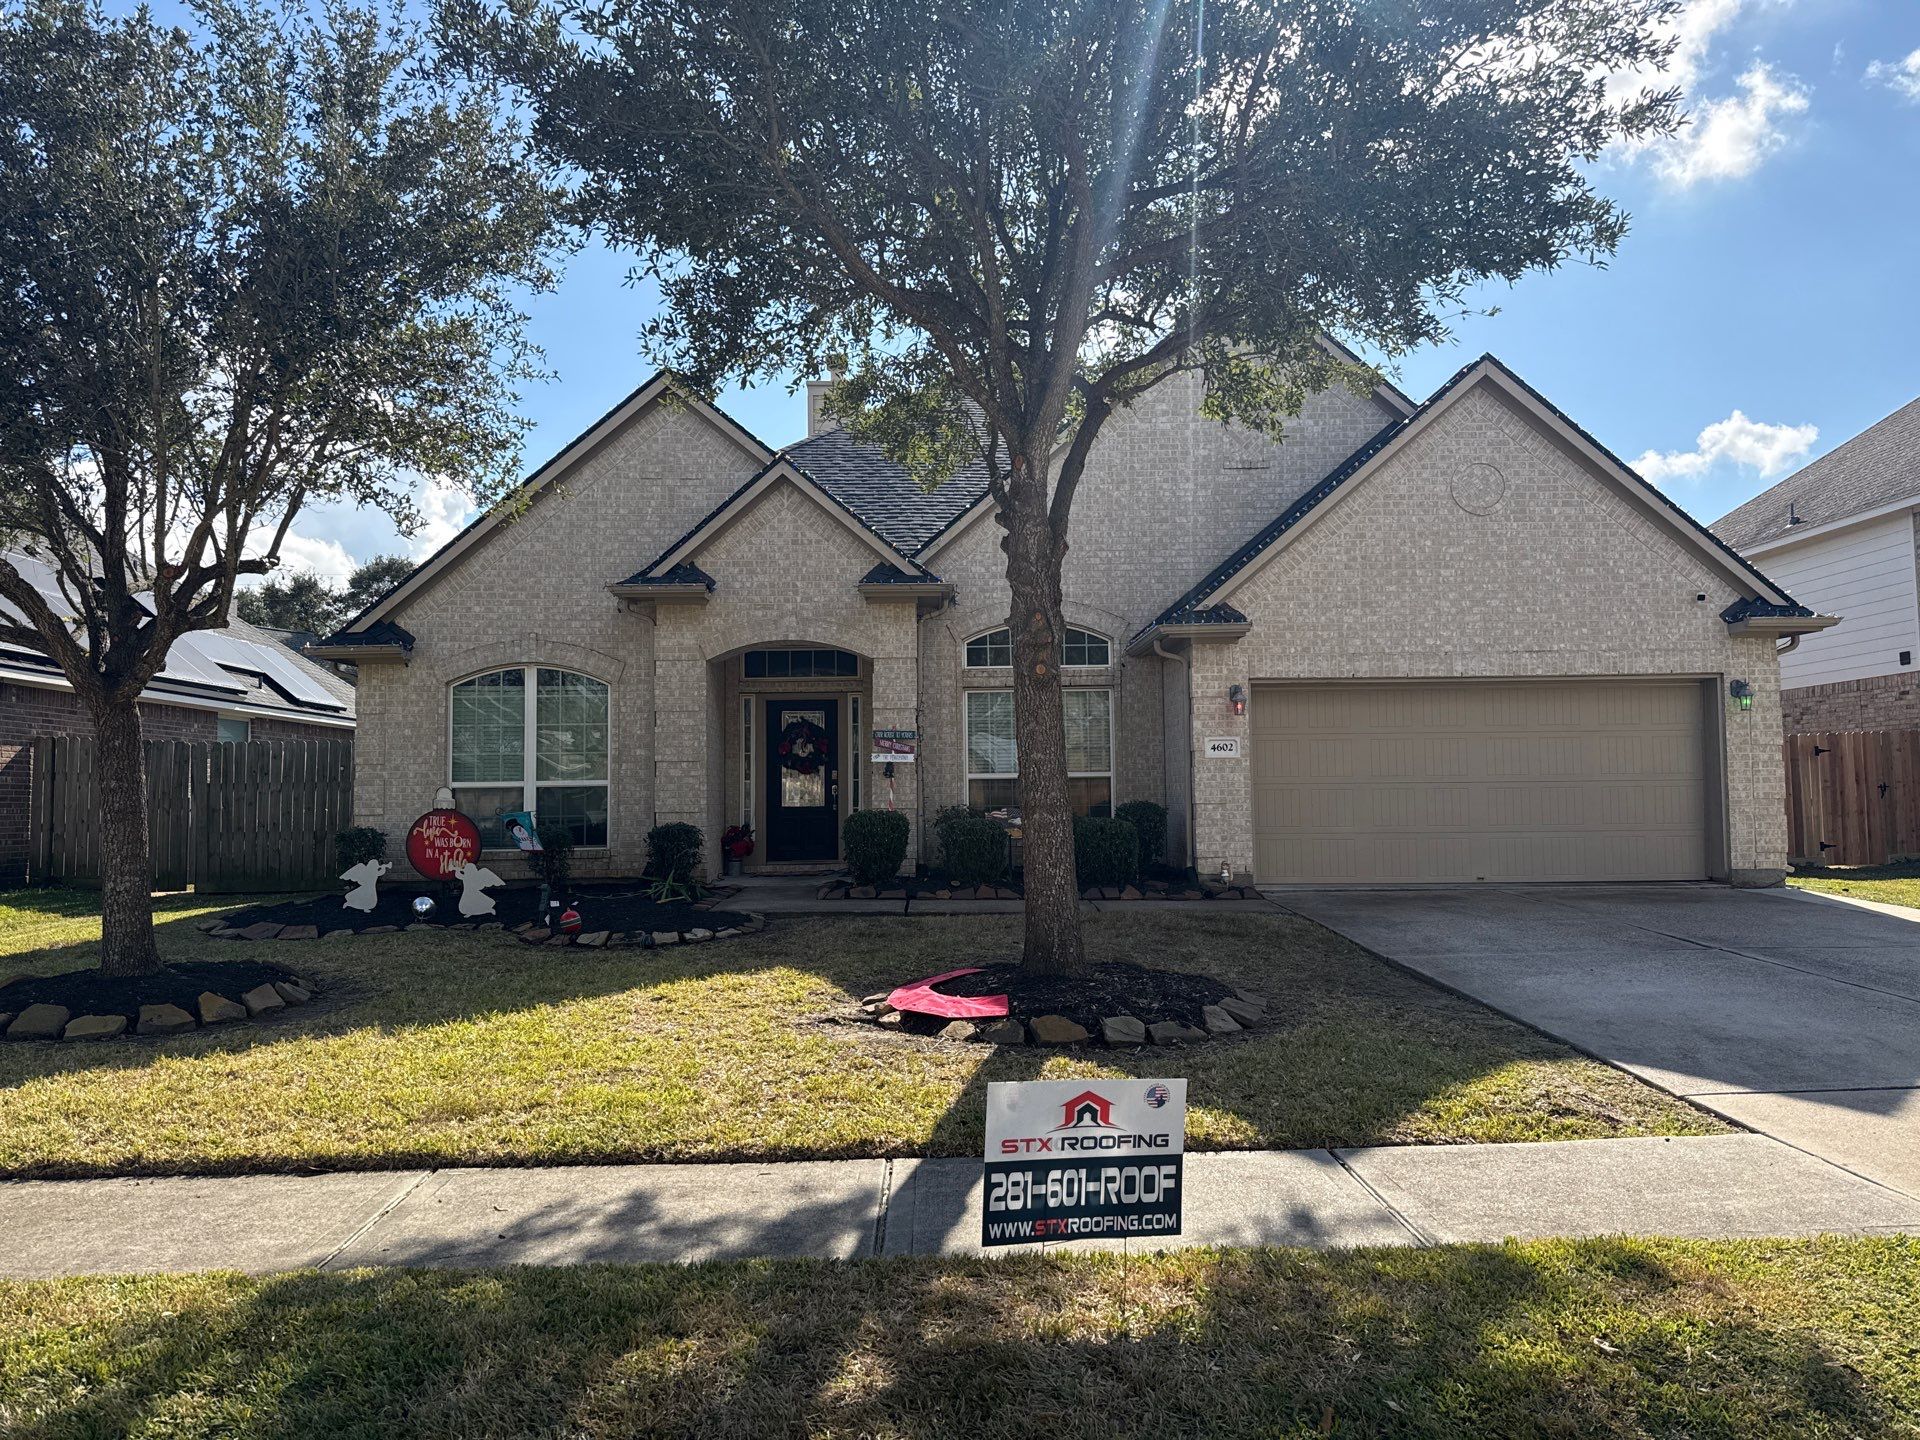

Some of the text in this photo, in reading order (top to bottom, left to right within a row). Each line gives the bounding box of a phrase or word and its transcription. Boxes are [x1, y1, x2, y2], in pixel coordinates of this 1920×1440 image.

[879, 740, 892, 749] MERRY
[1211, 743, 1234, 752] 4602
[429, 816, 446, 826] TRUE
[413, 819, 459, 841] love
[434, 836, 472, 848] WAS BORN
[426, 848, 439, 858] IN A
[1001, 1133, 1170, 1154] STX ROOFING
[989, 1165, 1177, 1212] 281-601-ROOF
[988, 1213, 1177, 1240] WWW.STXROOFING.COM
